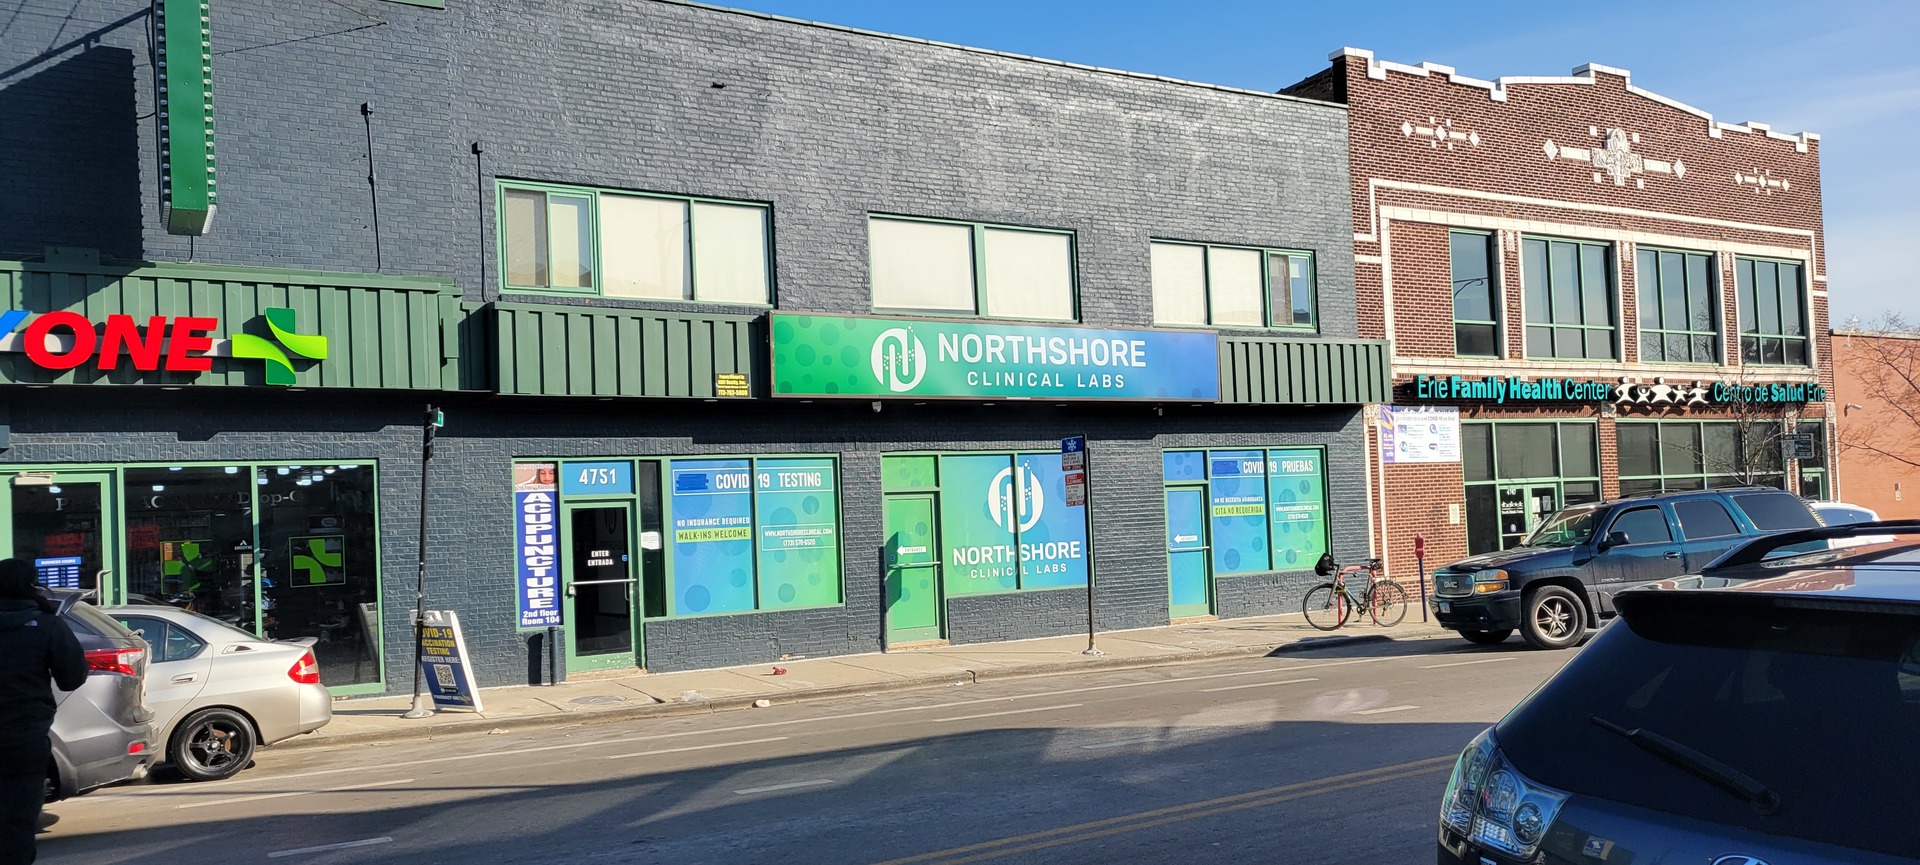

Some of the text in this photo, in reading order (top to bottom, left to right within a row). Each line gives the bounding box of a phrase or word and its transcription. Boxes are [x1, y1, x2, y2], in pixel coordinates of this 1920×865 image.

[937, 332, 1147, 368] NORTHSHORE
[966, 370, 1125, 389] CLINICAL LABS
[1418, 374, 1610, 403] Erie Family Health Center
[1714, 381, 1826, 402] Centro de Salud Erie
[1243, 461, 1264, 473] COVID
[1282, 460, 1313, 472] PRUEBAS
[579, 468, 616, 484] 4751
[715, 472, 821, 489] COVID 19 TESTING
[1215, 507, 1226, 515] CITA
[1235, 506, 1262, 514] REQUERIDA
[687, 518, 721, 526] INSURANCE
[722, 517, 749, 525] REQUIRED
[678, 529, 747, 541] WALK-INS WELCOME
[522, 492, 555, 609] ACUPUNCTURE
[591, 550, 610, 558] ENTER
[952, 541, 1081, 566] NORTHSHORE
[587, 559, 614, 567] ENTRADA
[970, 563, 1067, 579] CLINICL LABS
[522, 616, 560, 625] Room 104
[523, 609, 558, 618] 2nd floor
[426, 647, 450, 655] TESTING
